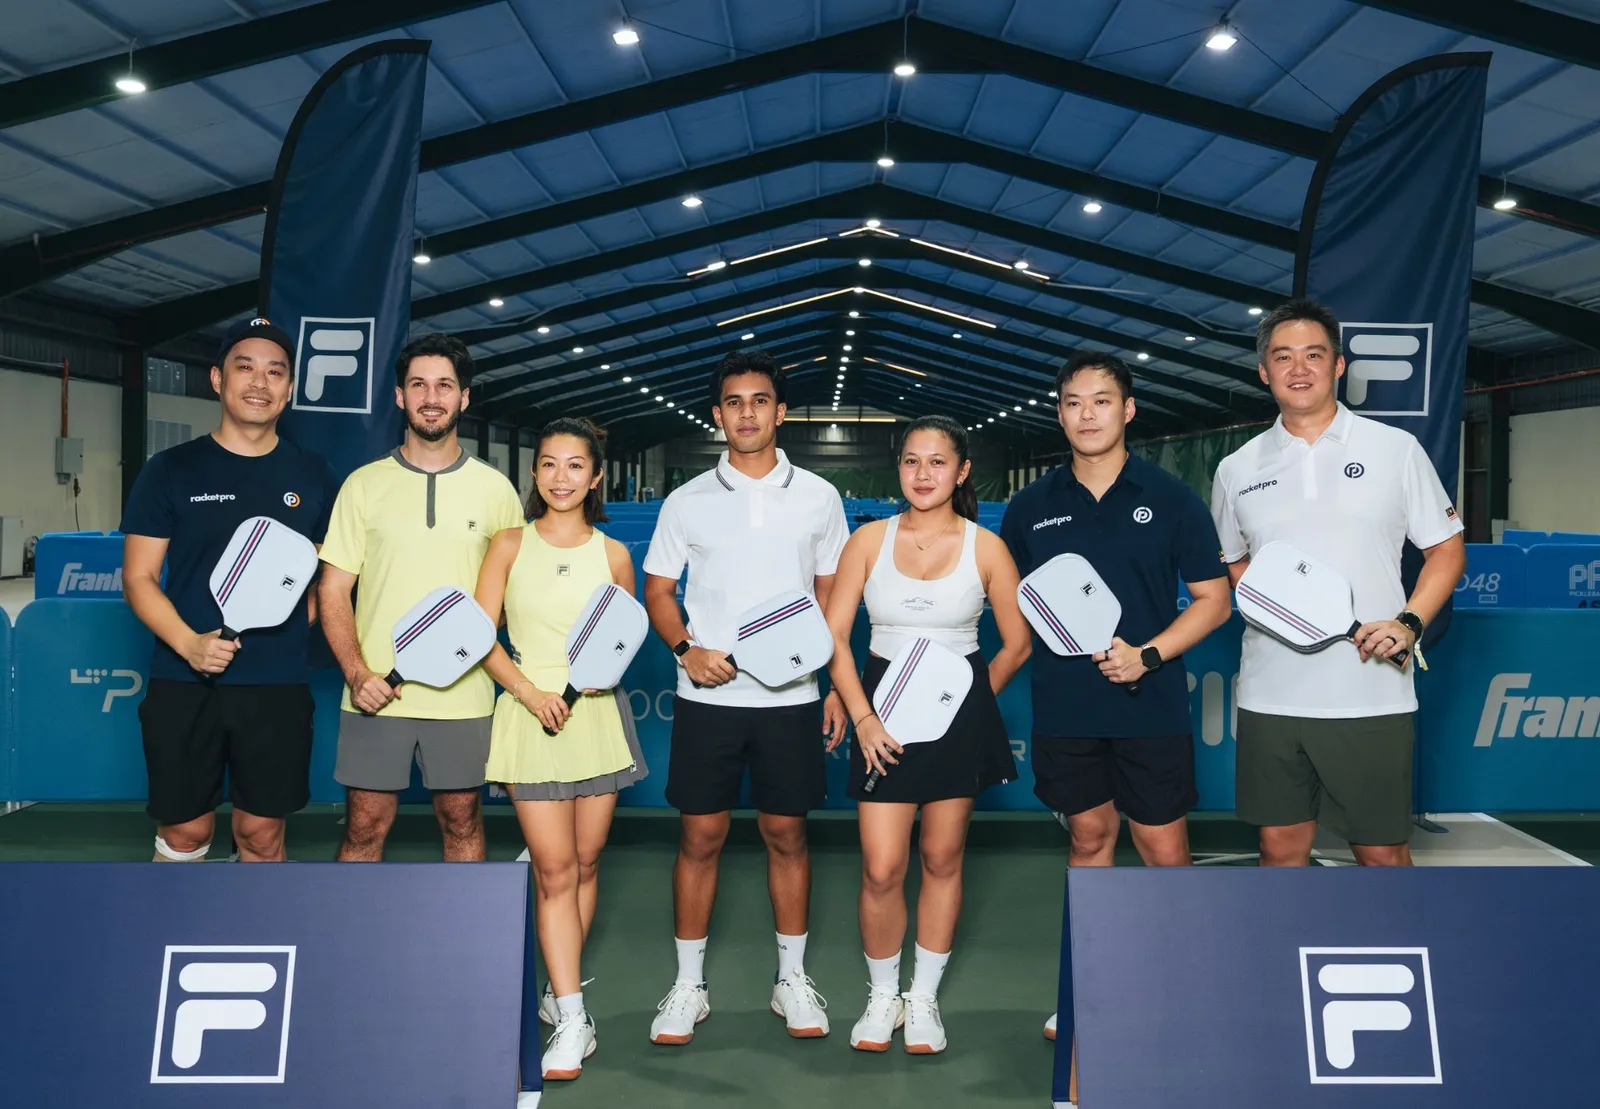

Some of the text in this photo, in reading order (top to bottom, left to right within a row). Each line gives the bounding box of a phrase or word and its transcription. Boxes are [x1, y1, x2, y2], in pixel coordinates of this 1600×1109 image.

[305, 329, 364, 401] F
[1346, 334, 1420, 405] F
[190, 493, 235, 503] racketpro
[1033, 515, 1072, 531] racketpro
[1473, 673, 1600, 747] fran
[172, 962, 277, 1069] F
[1318, 964, 1415, 1070] F
